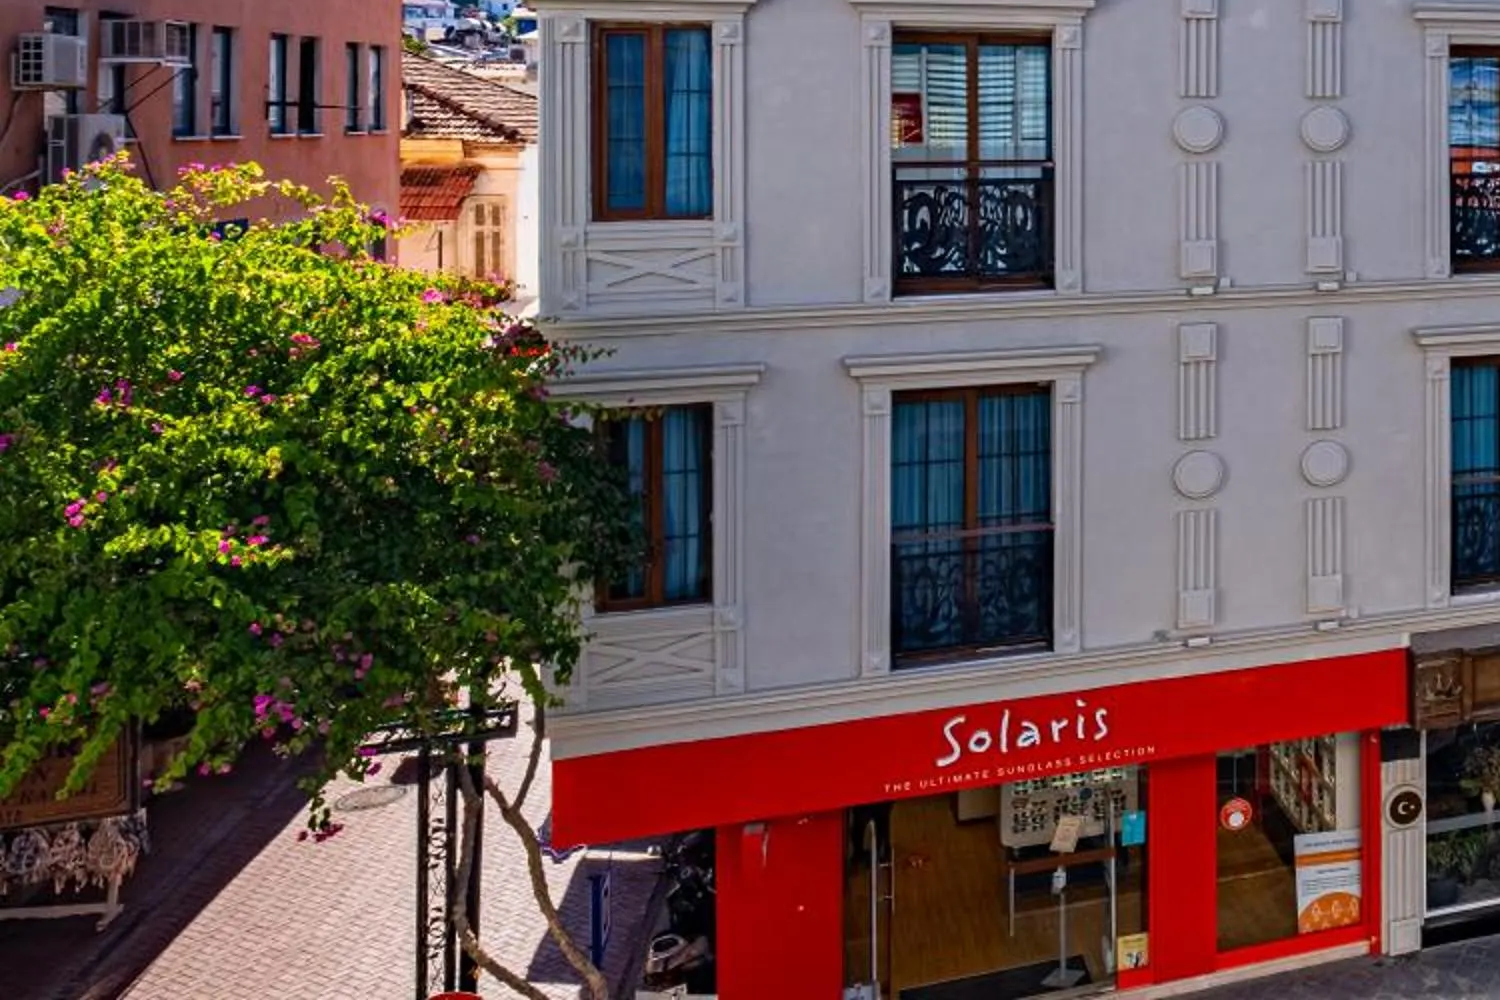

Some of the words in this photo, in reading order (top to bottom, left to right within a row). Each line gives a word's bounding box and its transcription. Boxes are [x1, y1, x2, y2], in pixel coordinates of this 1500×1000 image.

[935, 699, 1108, 767] Solaris
[884, 781, 911, 792] THE
[920, 769, 989, 789] ULTIMATE
[997, 757, 1071, 777] SUNGLASS
[1080, 746, 1155, 765] SELECTION
